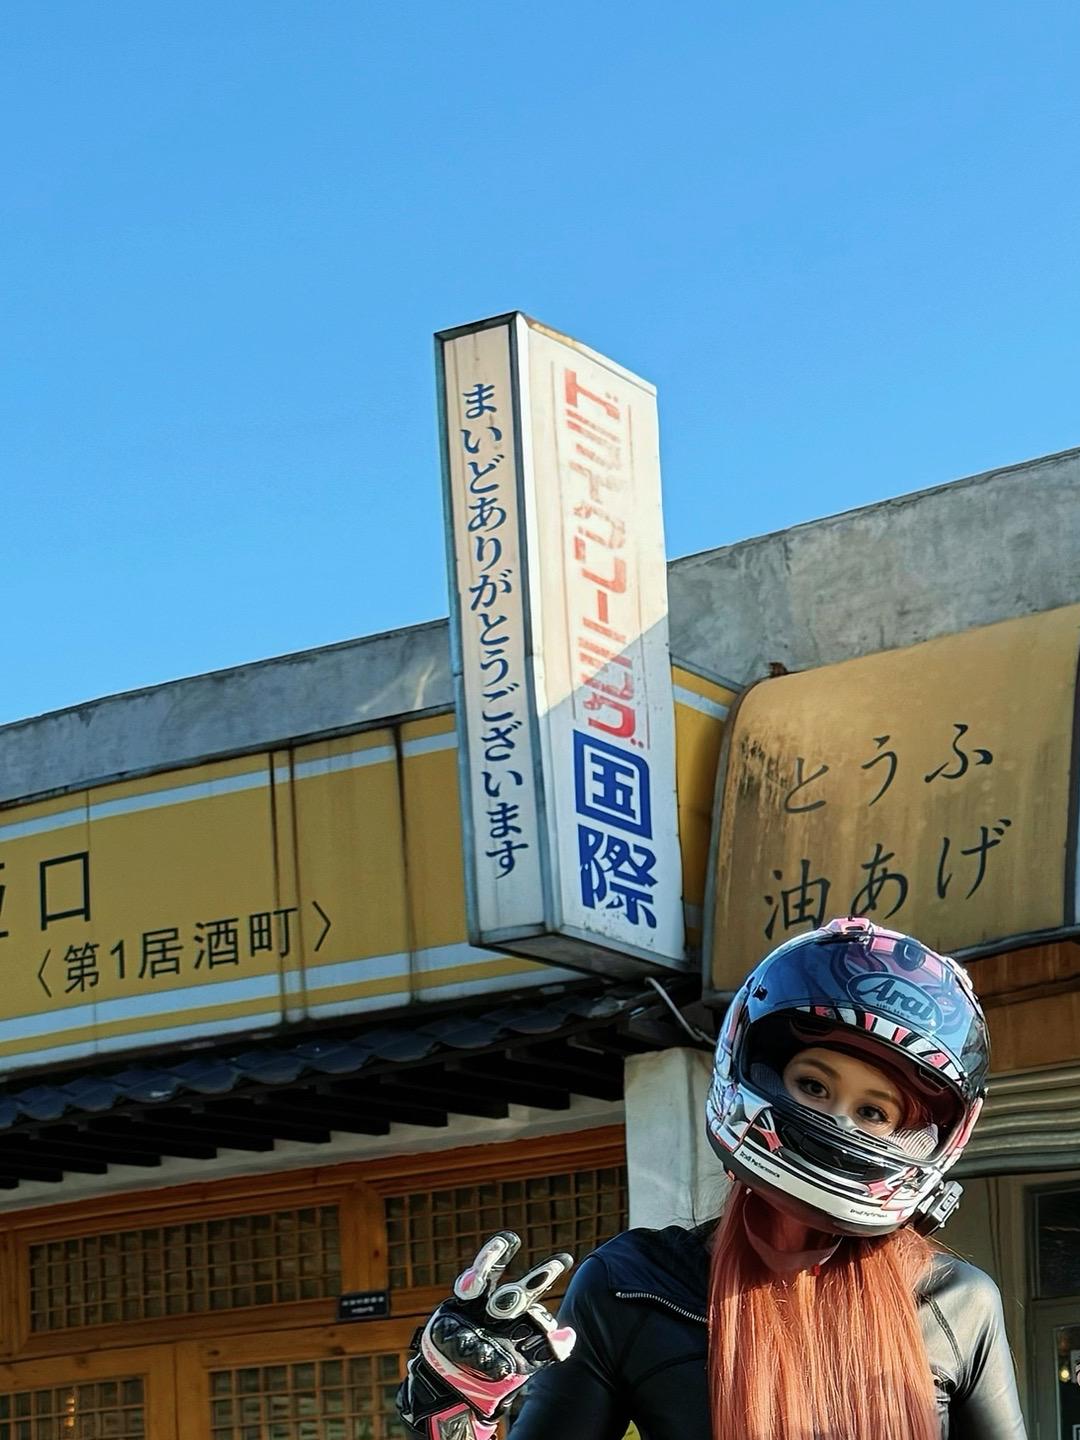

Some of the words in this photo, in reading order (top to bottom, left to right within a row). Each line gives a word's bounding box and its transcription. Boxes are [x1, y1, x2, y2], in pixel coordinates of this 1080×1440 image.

[461, 383, 529, 879] まいどありがとうございます
[783, 724, 993, 814] とうふ
[573, 729, 657, 929] 国際
[764, 819, 1011, 939] 油あげ
[0, 850, 91, 937] 口
[857, 978, 936, 1021] Arai
